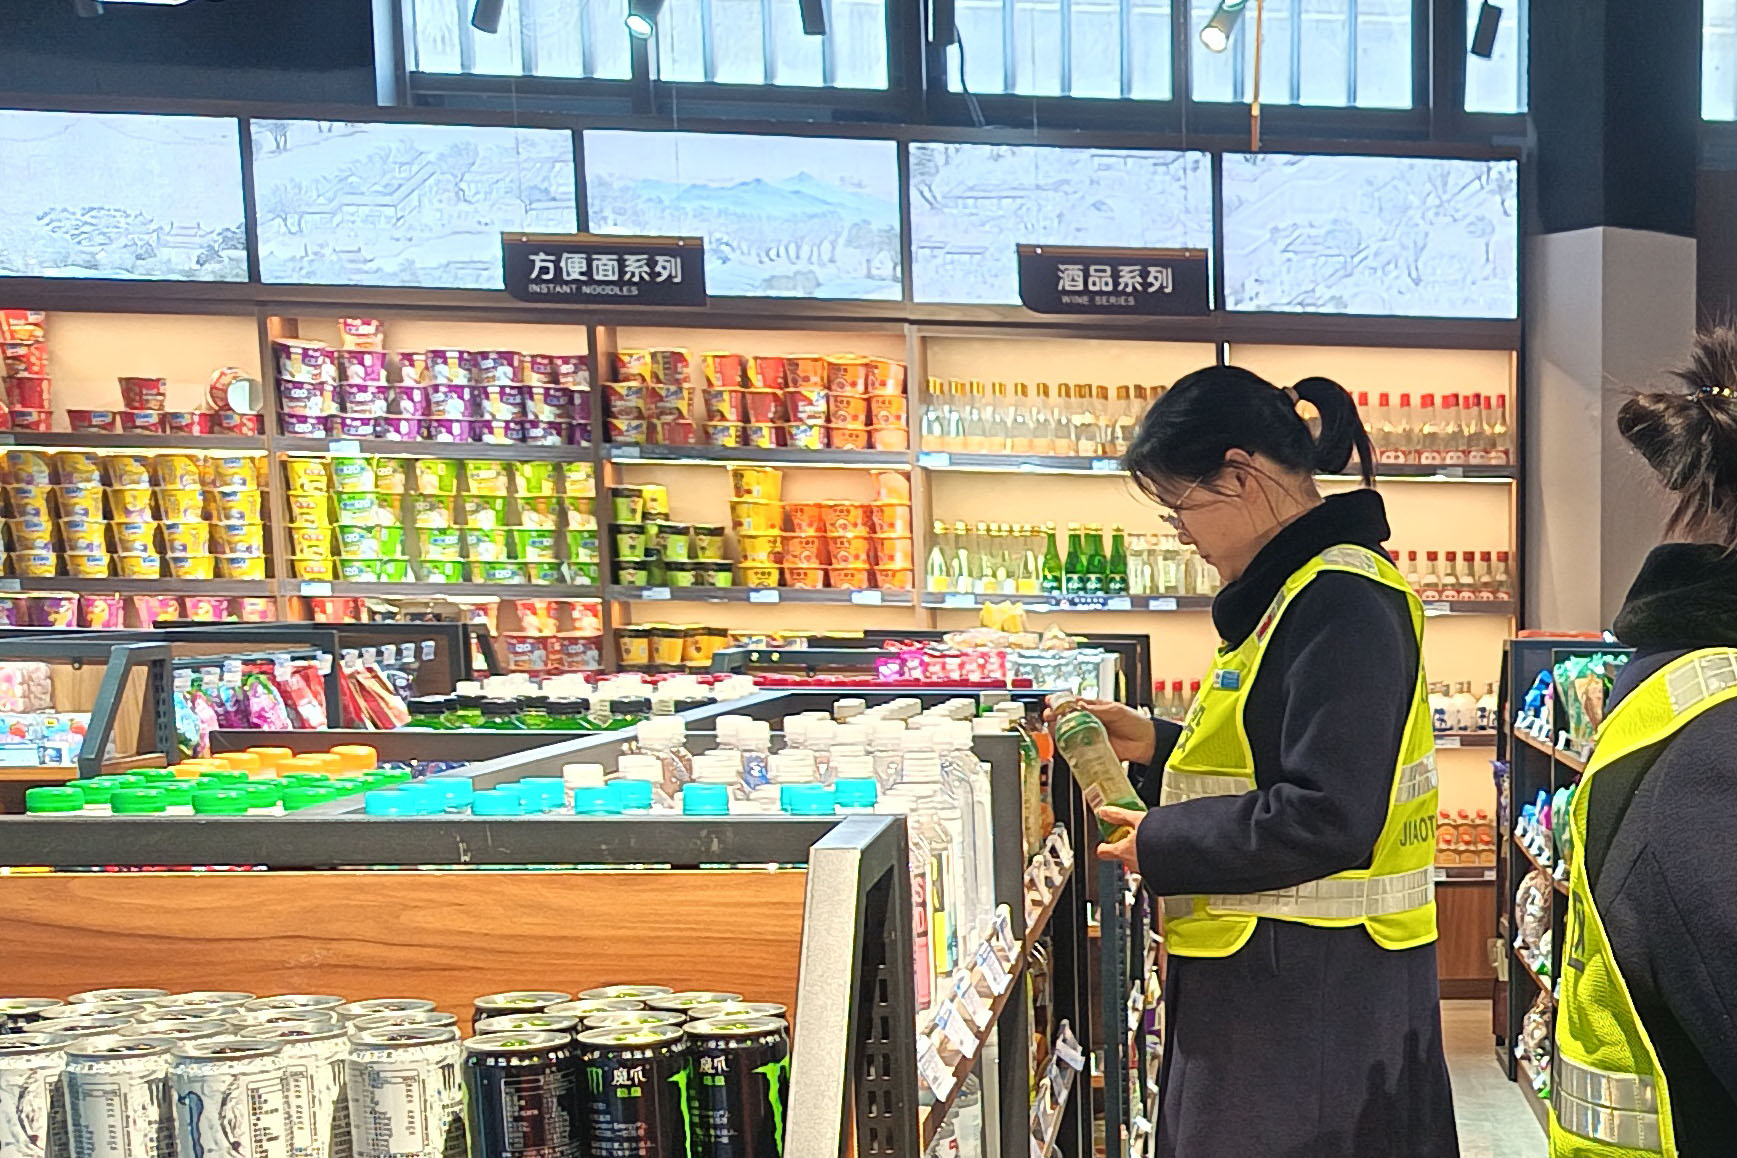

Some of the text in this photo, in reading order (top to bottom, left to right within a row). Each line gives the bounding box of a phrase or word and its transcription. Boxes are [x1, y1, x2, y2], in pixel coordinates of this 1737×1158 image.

[528, 252, 682, 283] 方便面系列
[1057, 264, 1173, 294] 酒品系列
[528, 284, 639, 296] INSTANT NOODLES
[1095, 296, 1136, 306] SERIES
